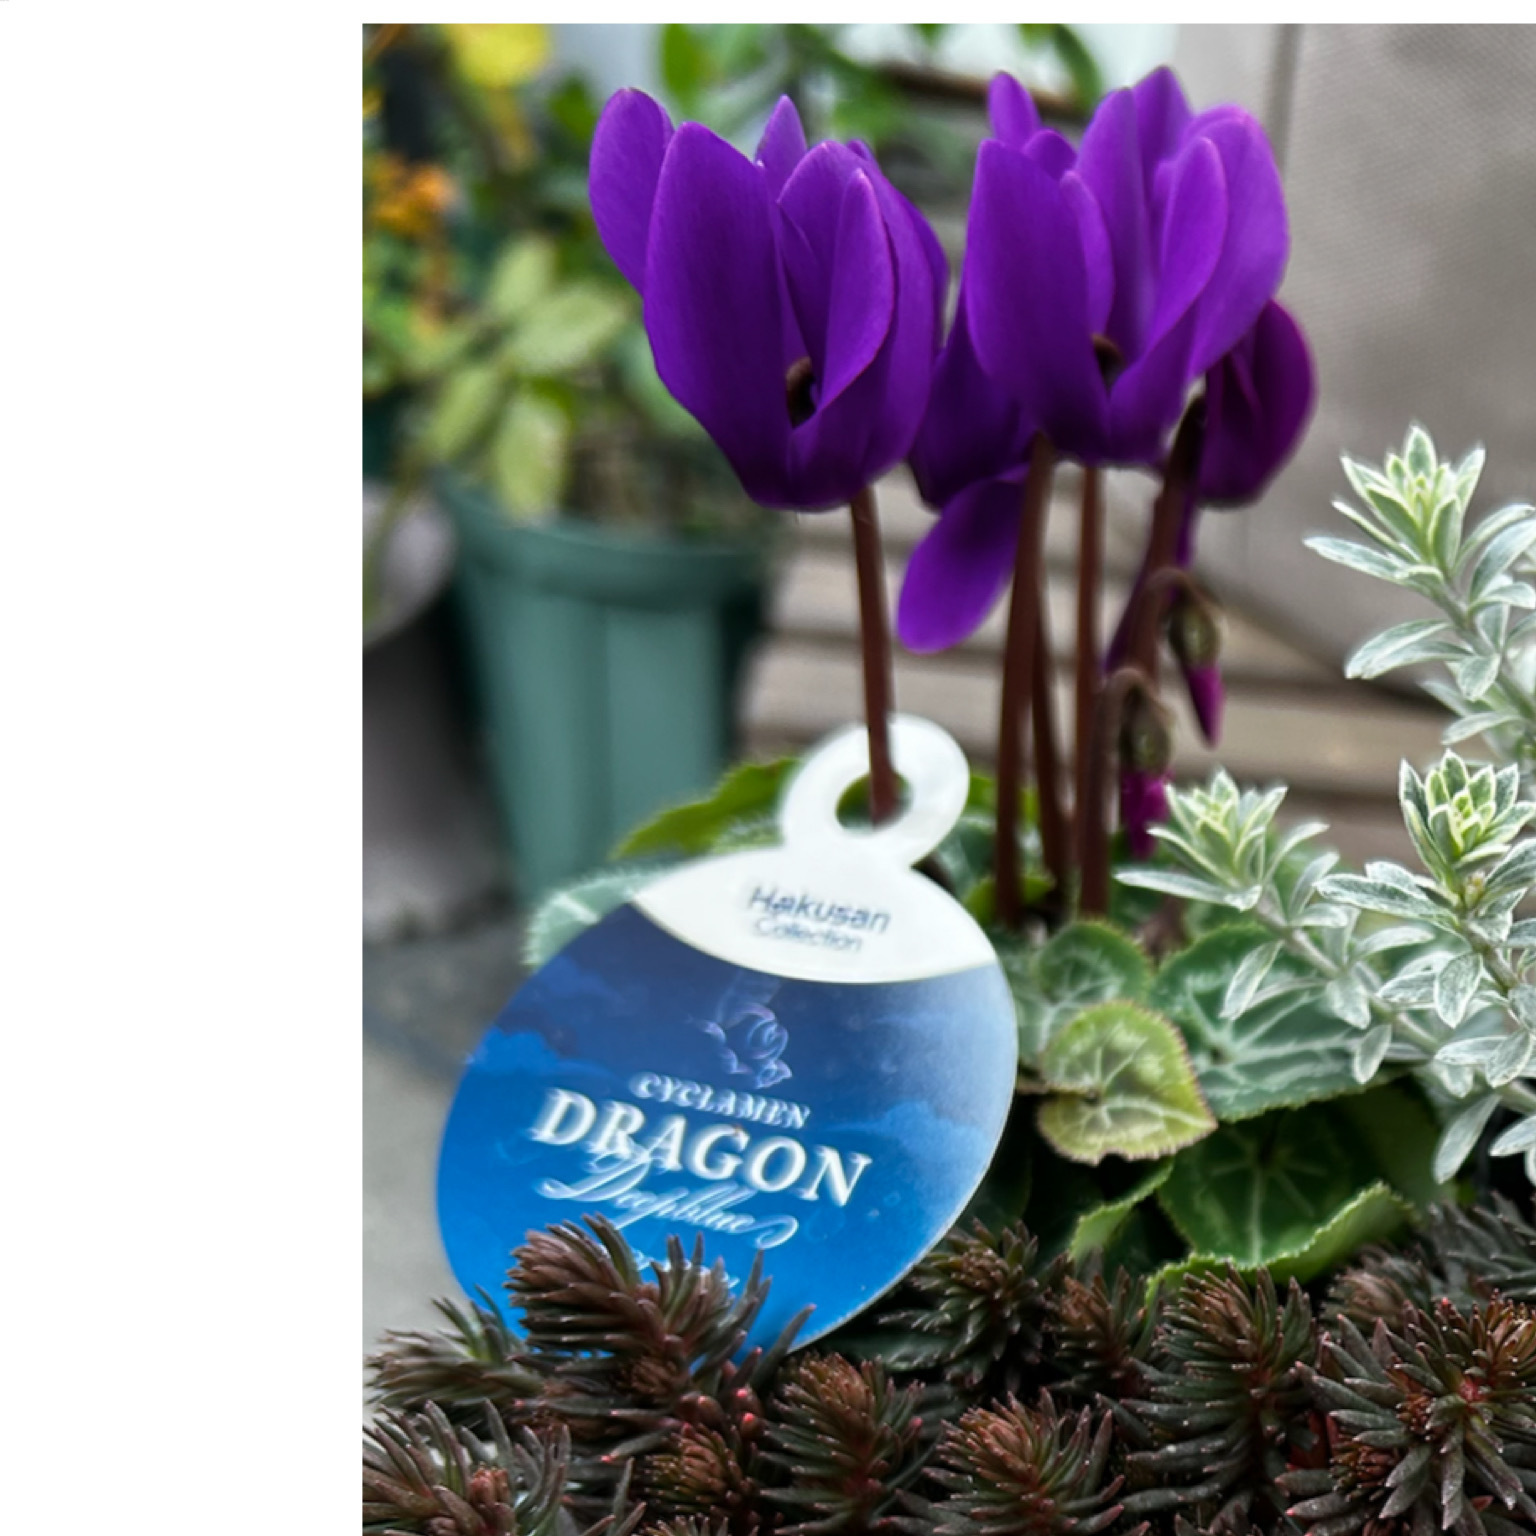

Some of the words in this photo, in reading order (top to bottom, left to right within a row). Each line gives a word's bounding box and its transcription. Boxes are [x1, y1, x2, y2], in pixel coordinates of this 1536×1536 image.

[749, 886, 891, 934] Hakusan
[755, 917, 862, 952] Collection
[631, 1071, 811, 1130] CYCLAMEN
[530, 1088, 873, 1208] DRAGON
